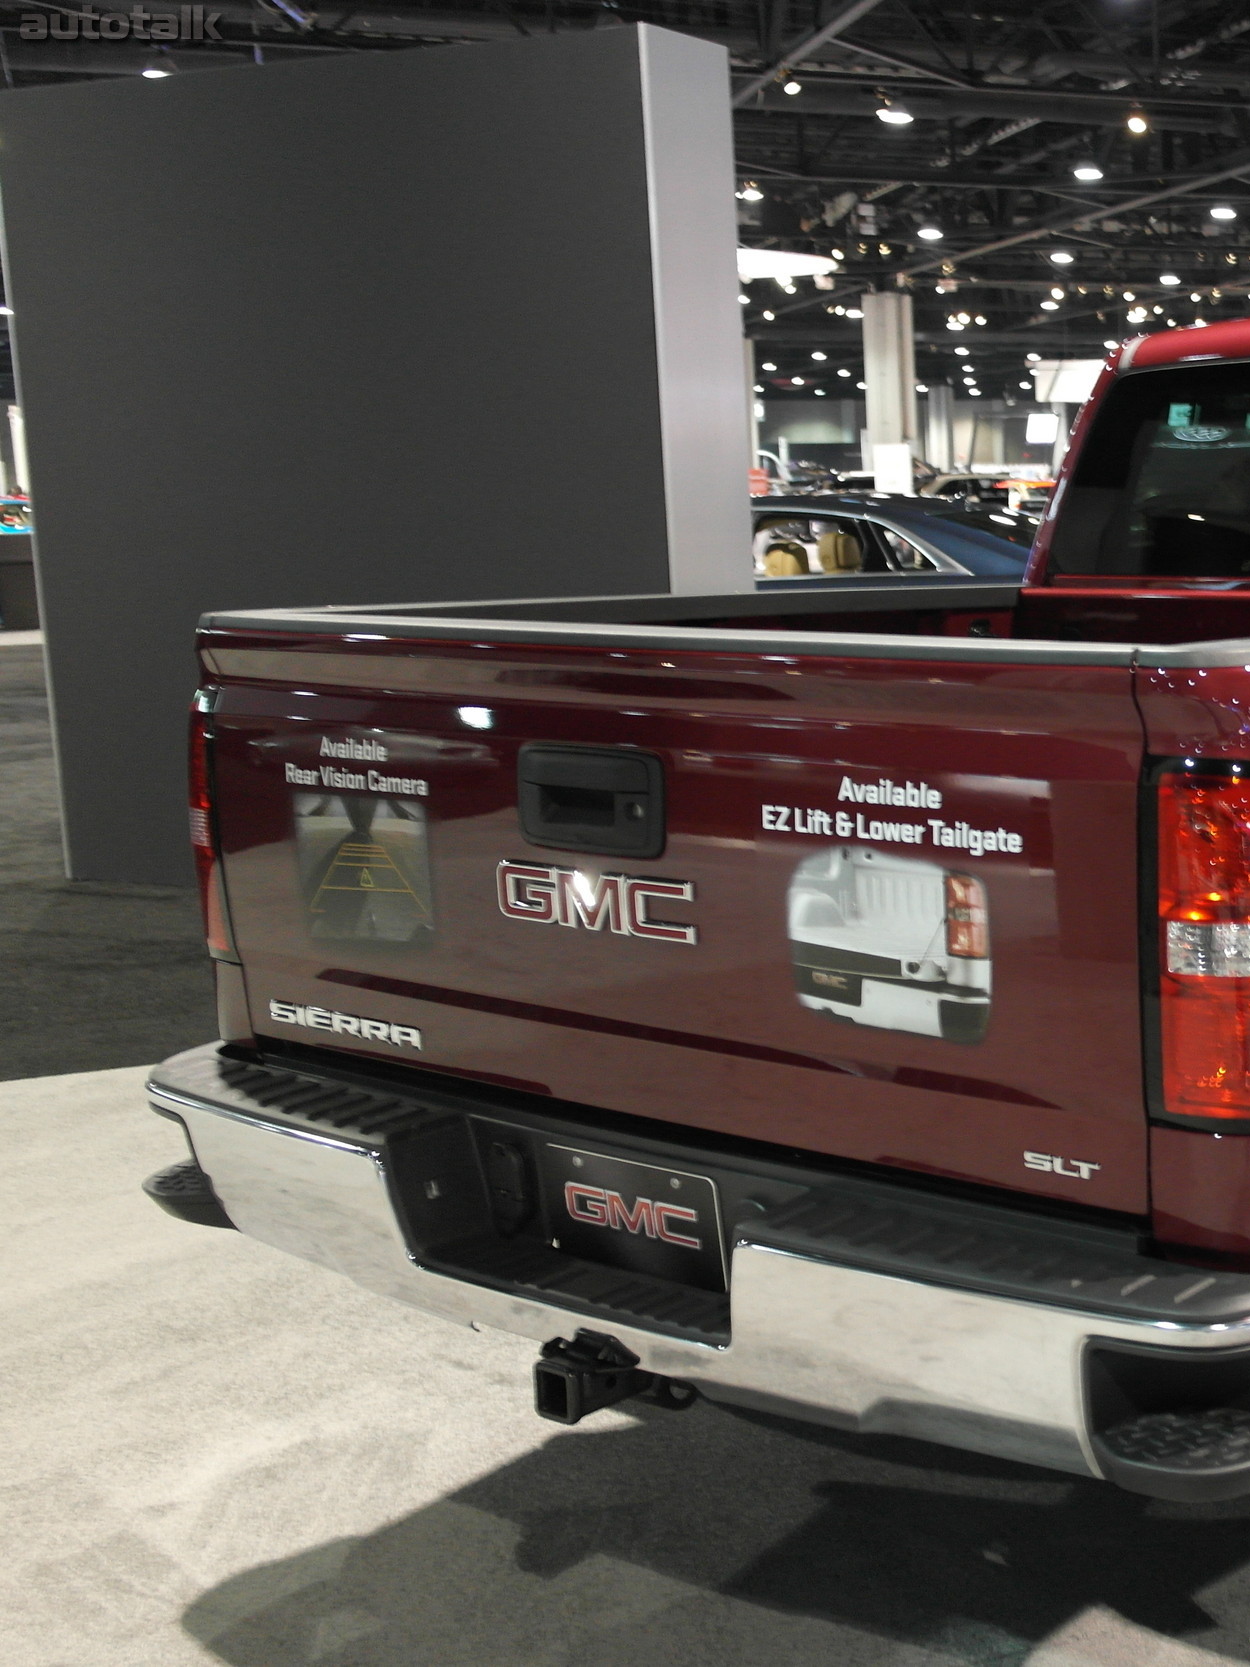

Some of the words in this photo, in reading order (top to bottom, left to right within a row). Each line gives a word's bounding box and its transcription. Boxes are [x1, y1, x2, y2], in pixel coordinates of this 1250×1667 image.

[320, 736, 388, 761] Available
[285, 762, 320, 786] Rear
[320, 765, 367, 790] Vision
[367, 769, 429, 796] Camera
[838, 776, 942, 809] Available
[761, 804, 791, 832] EZ
[794, 807, 833, 836] Lift
[835, 811, 854, 837] &
[856, 813, 926, 844] Lower
[927, 818, 1023, 856] Tailgate
[496, 858, 698, 945] GMC
[269, 999, 423, 1051] SIERRA
[1023, 1151, 1101, 1180] SLT
[564, 1181, 703, 1250] GMC
